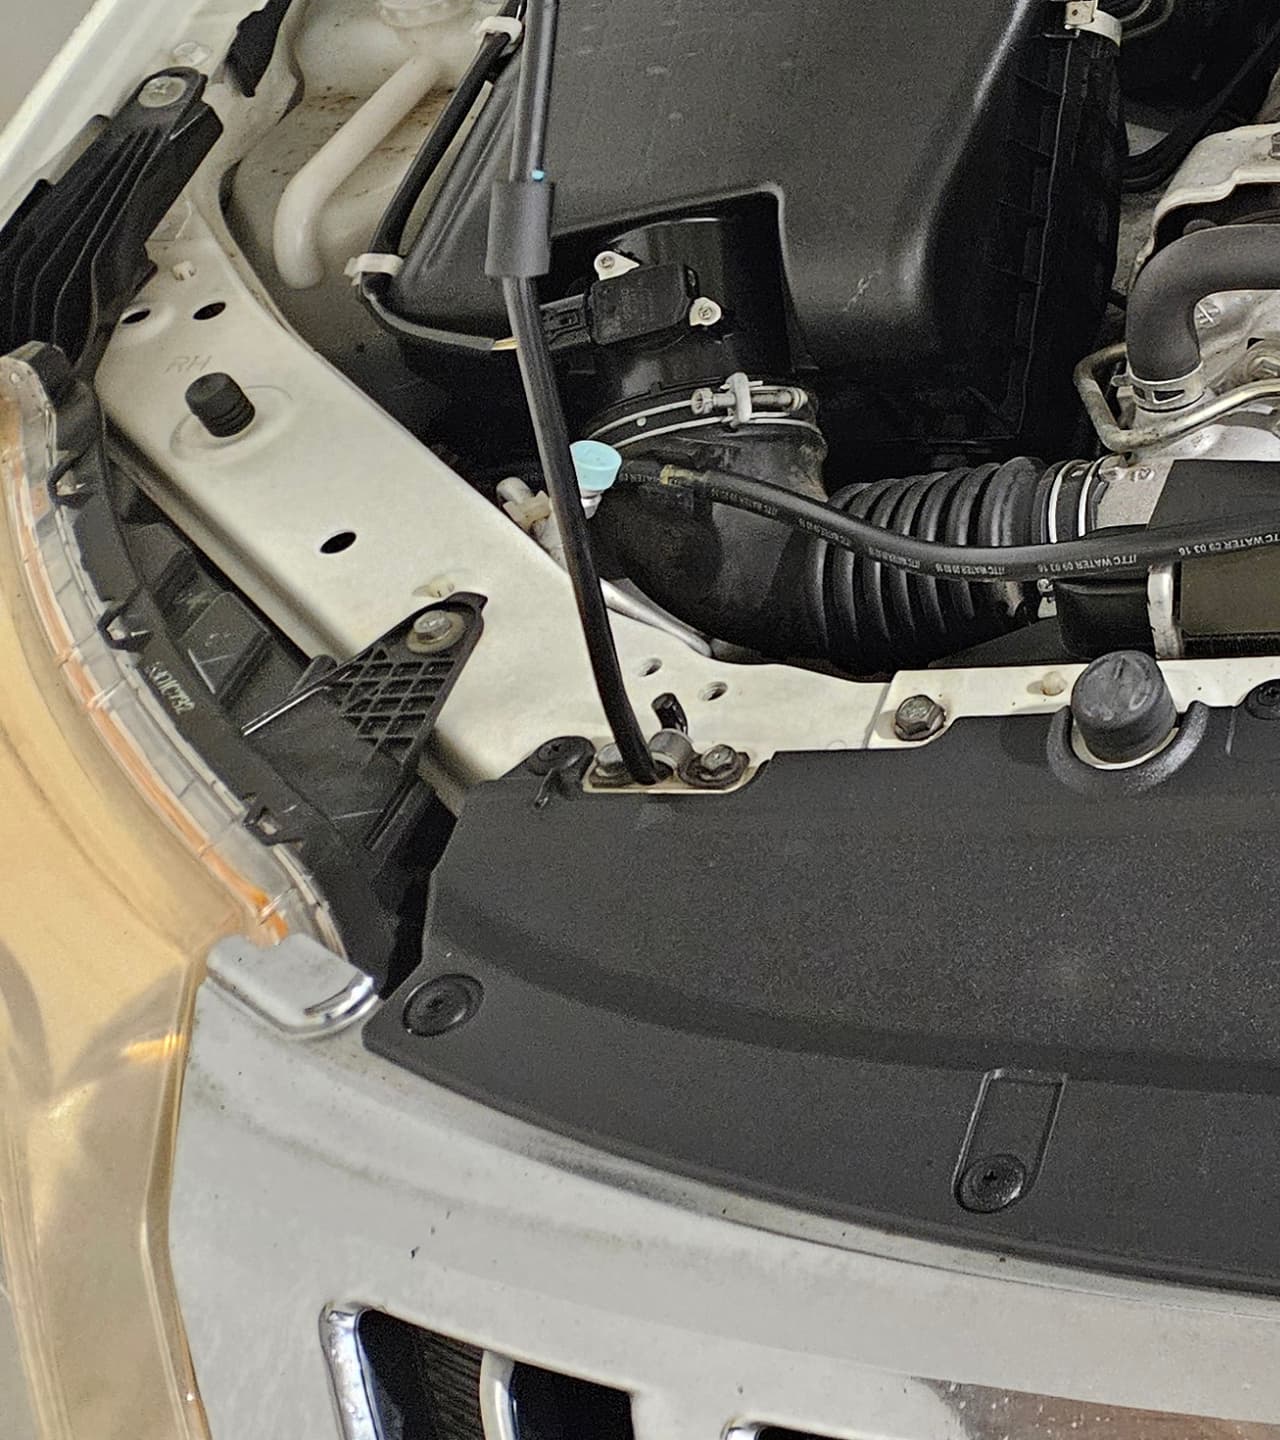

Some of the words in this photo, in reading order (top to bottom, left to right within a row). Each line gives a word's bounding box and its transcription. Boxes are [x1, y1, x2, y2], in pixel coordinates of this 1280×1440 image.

[1222, 534, 1265, 549] WATER
[1178, 546, 1191, 556] 16
[1193, 544, 1206, 555] 03
[1037, 563, 1048, 572] 16
[1075, 556, 1112, 570] WATER
